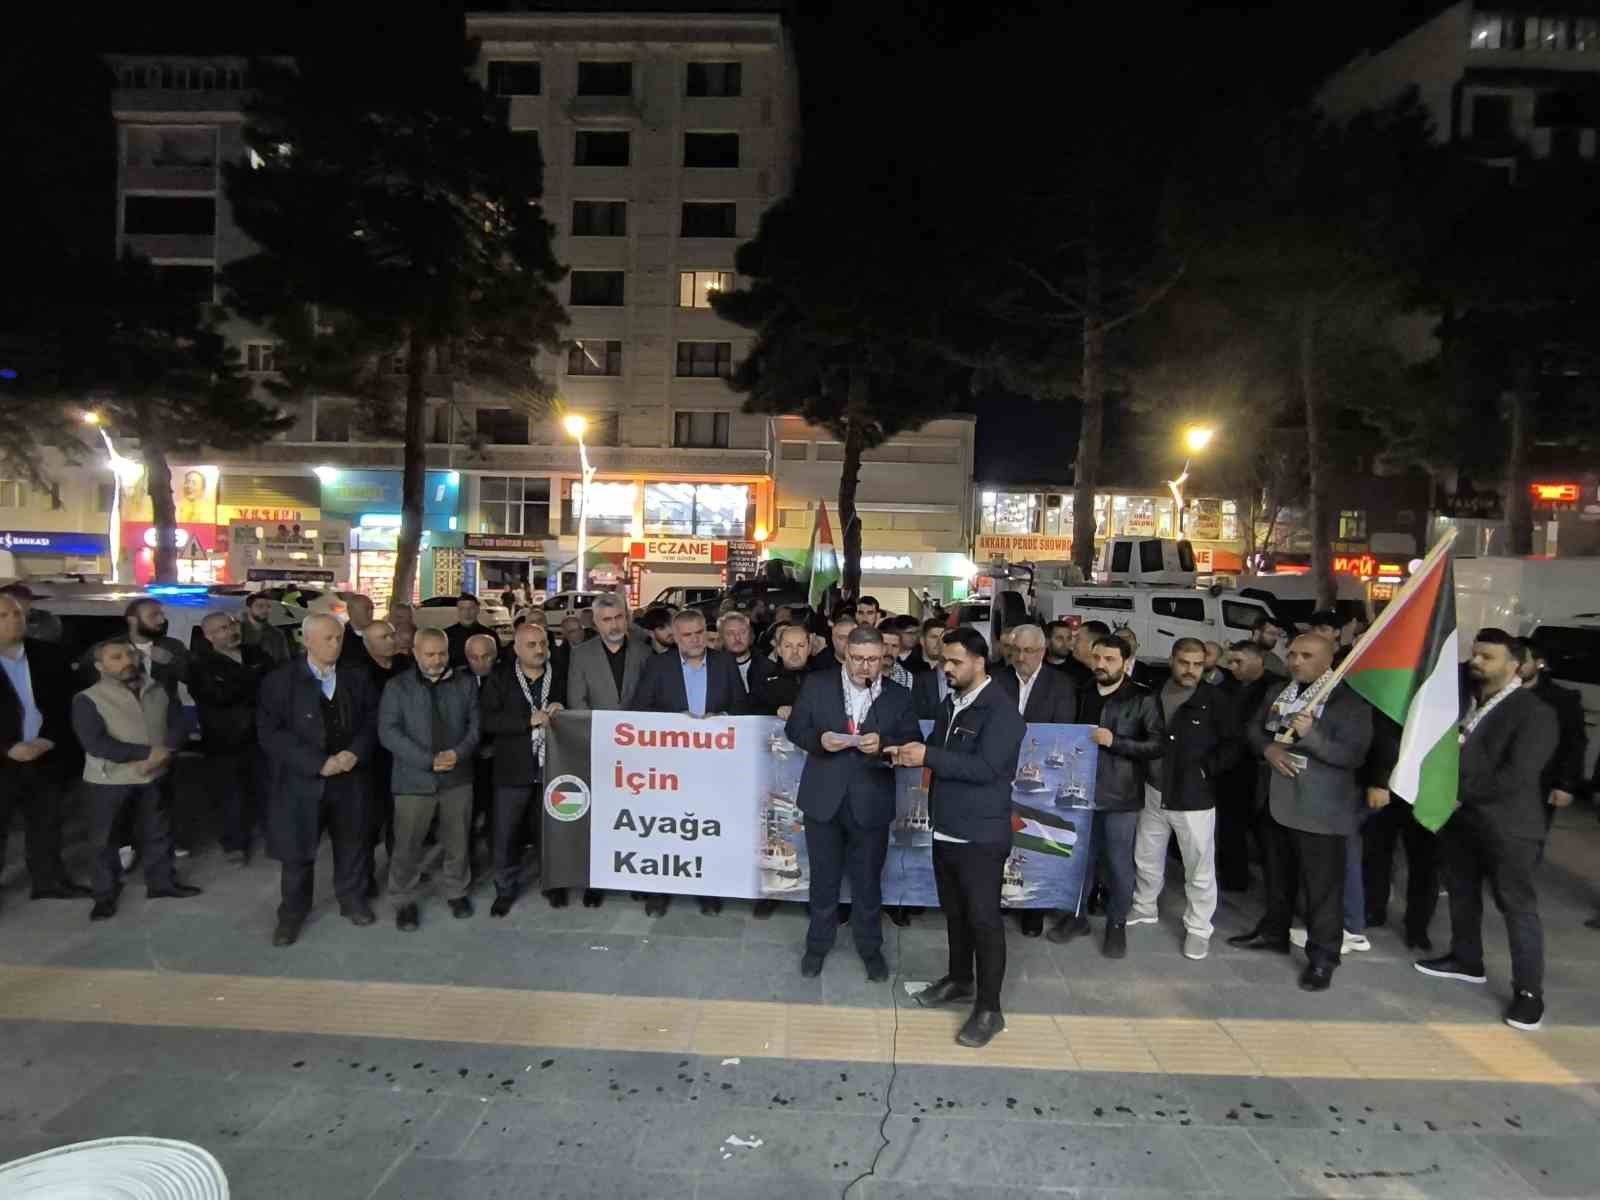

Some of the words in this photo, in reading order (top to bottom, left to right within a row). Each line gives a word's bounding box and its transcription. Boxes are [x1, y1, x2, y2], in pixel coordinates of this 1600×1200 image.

[648, 541, 709, 555] ECZANE
[980, 537, 1010, 550] ANKARA
[1012, 538, 1038, 551] PERDE
[1039, 538, 1072, 551] SHOWRO
[614, 722, 736, 750] Sumud
[614, 760, 680, 795] İçin
[613, 808, 721, 841] Ayağa
[614, 851, 703, 878] Kalk!
